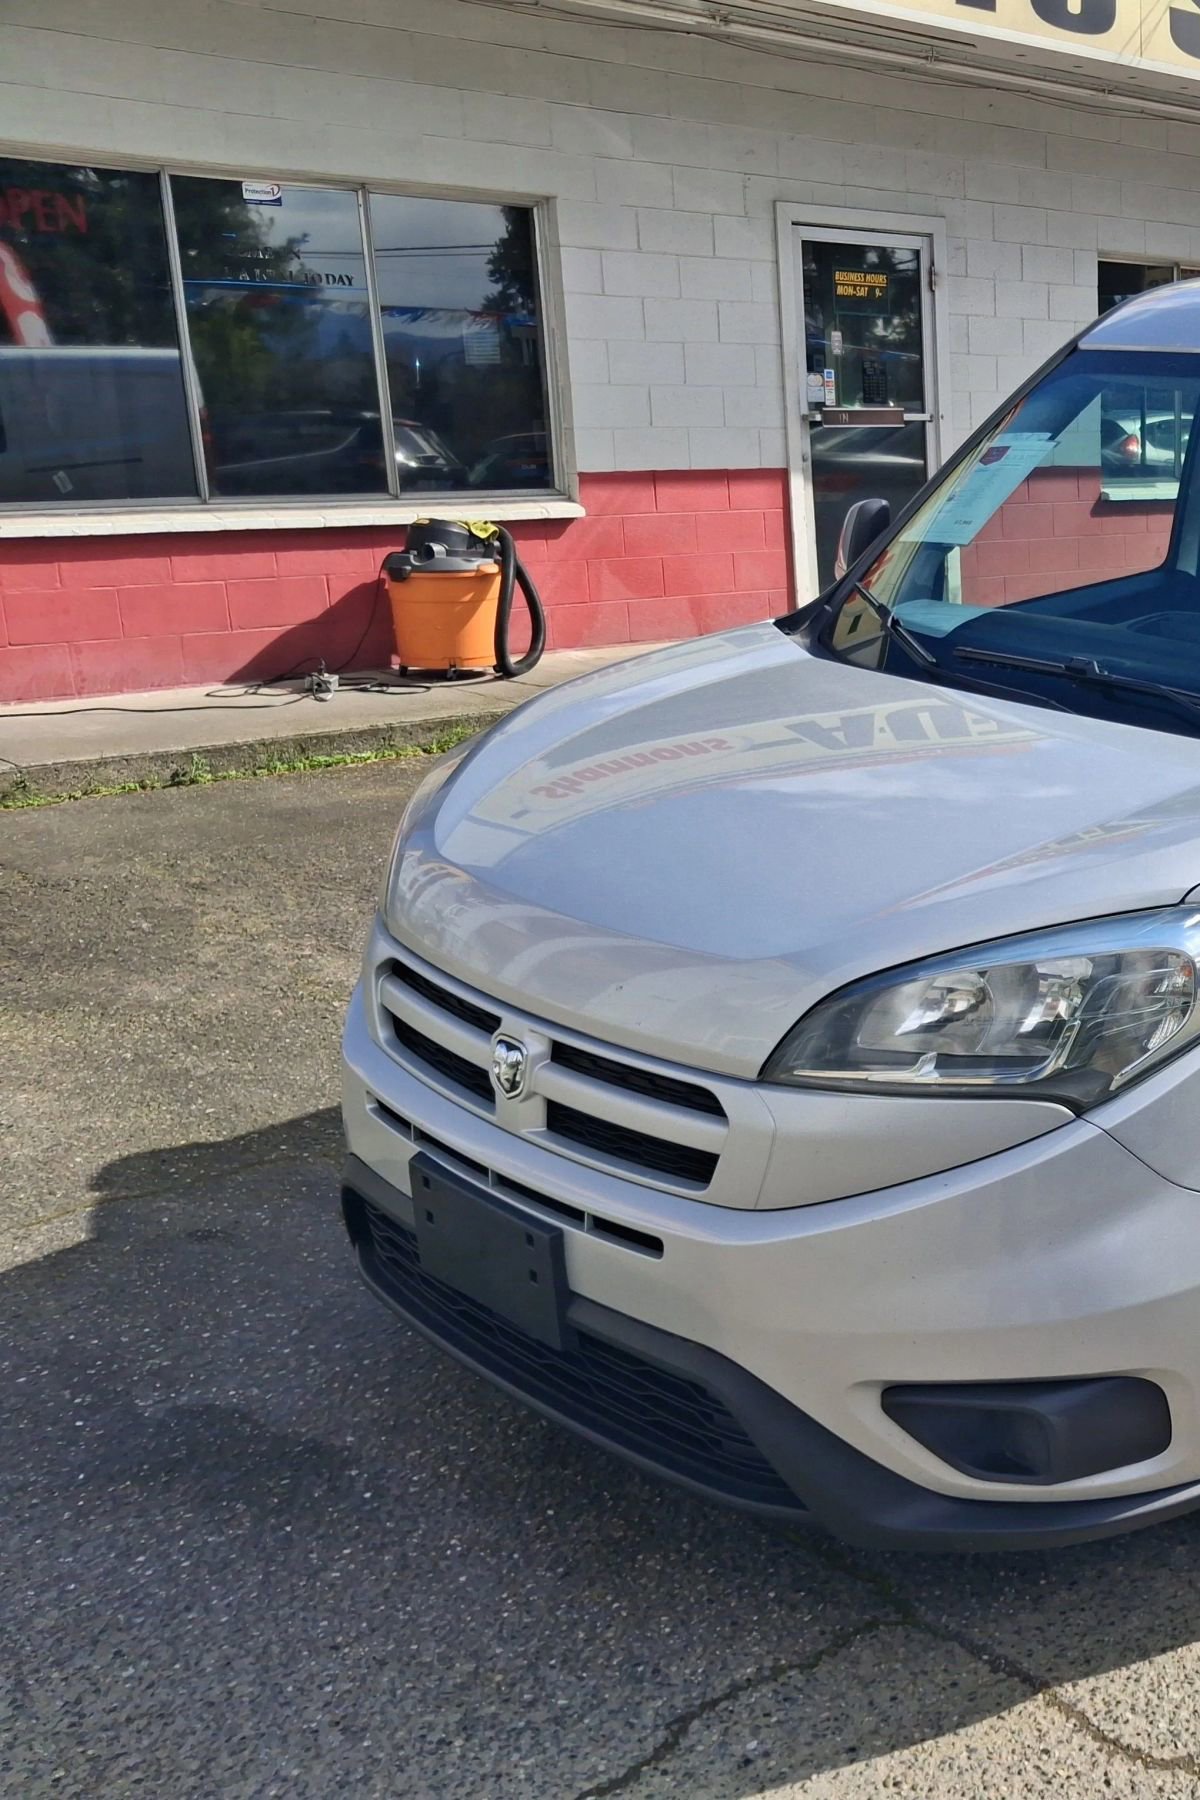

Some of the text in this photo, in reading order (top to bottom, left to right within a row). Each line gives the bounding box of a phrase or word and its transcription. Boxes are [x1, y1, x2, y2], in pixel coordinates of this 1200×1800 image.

[835, 271, 887, 284] BUSINESS HOURS
[836, 285, 869, 297] MON-SAT
